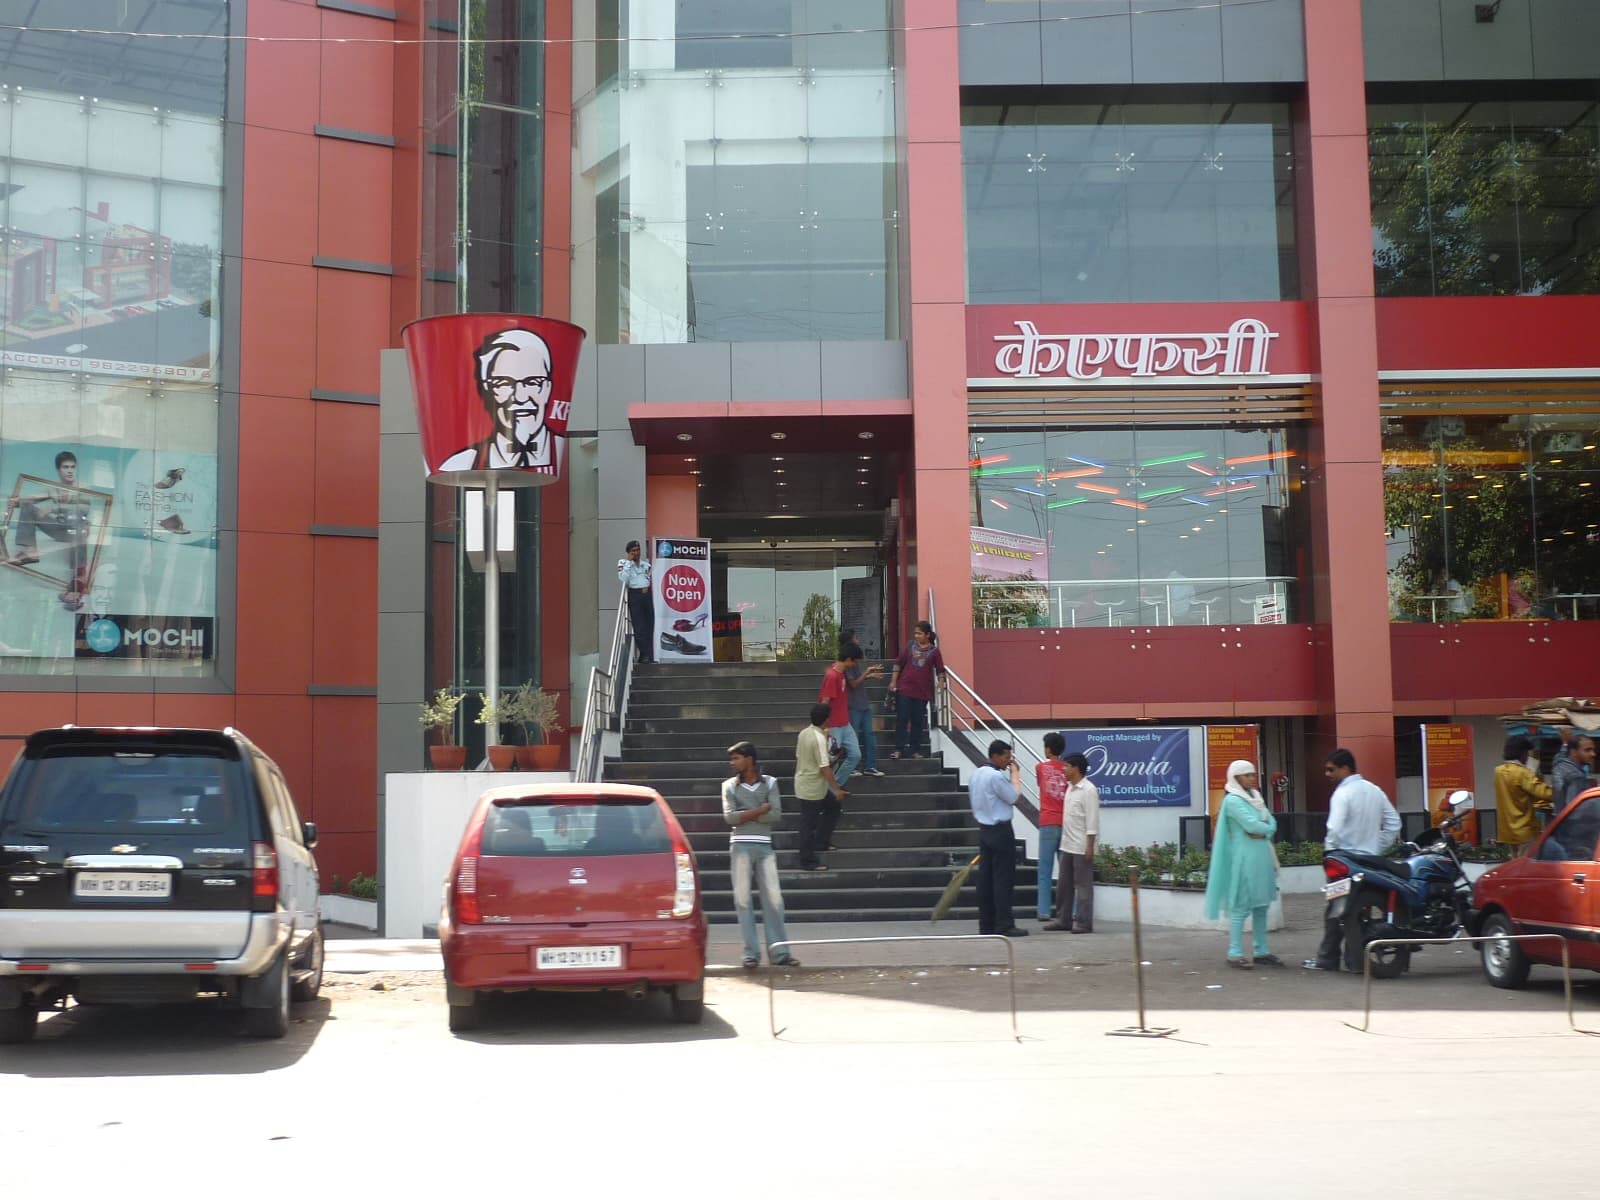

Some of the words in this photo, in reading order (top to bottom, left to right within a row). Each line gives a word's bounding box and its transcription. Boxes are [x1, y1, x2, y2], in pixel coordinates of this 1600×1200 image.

[994, 318, 1279, 380] केएफसी
[2, 353, 81, 367] ACCORD
[135, 491, 194, 503] FASHION
[673, 545, 706, 555] MOCHI
[668, 574, 698, 587] Now
[666, 587, 701, 603] Open
[124, 628, 204, 647] MOCHI
[1087, 734, 1114, 743] Project
[1115, 733, 1150, 742] Managed
[1151, 733, 1162, 742] by
[1083, 745, 1172, 778] Omnia
[1114, 784, 1177, 795] Consultants
[102, 879, 114, 891] 12
